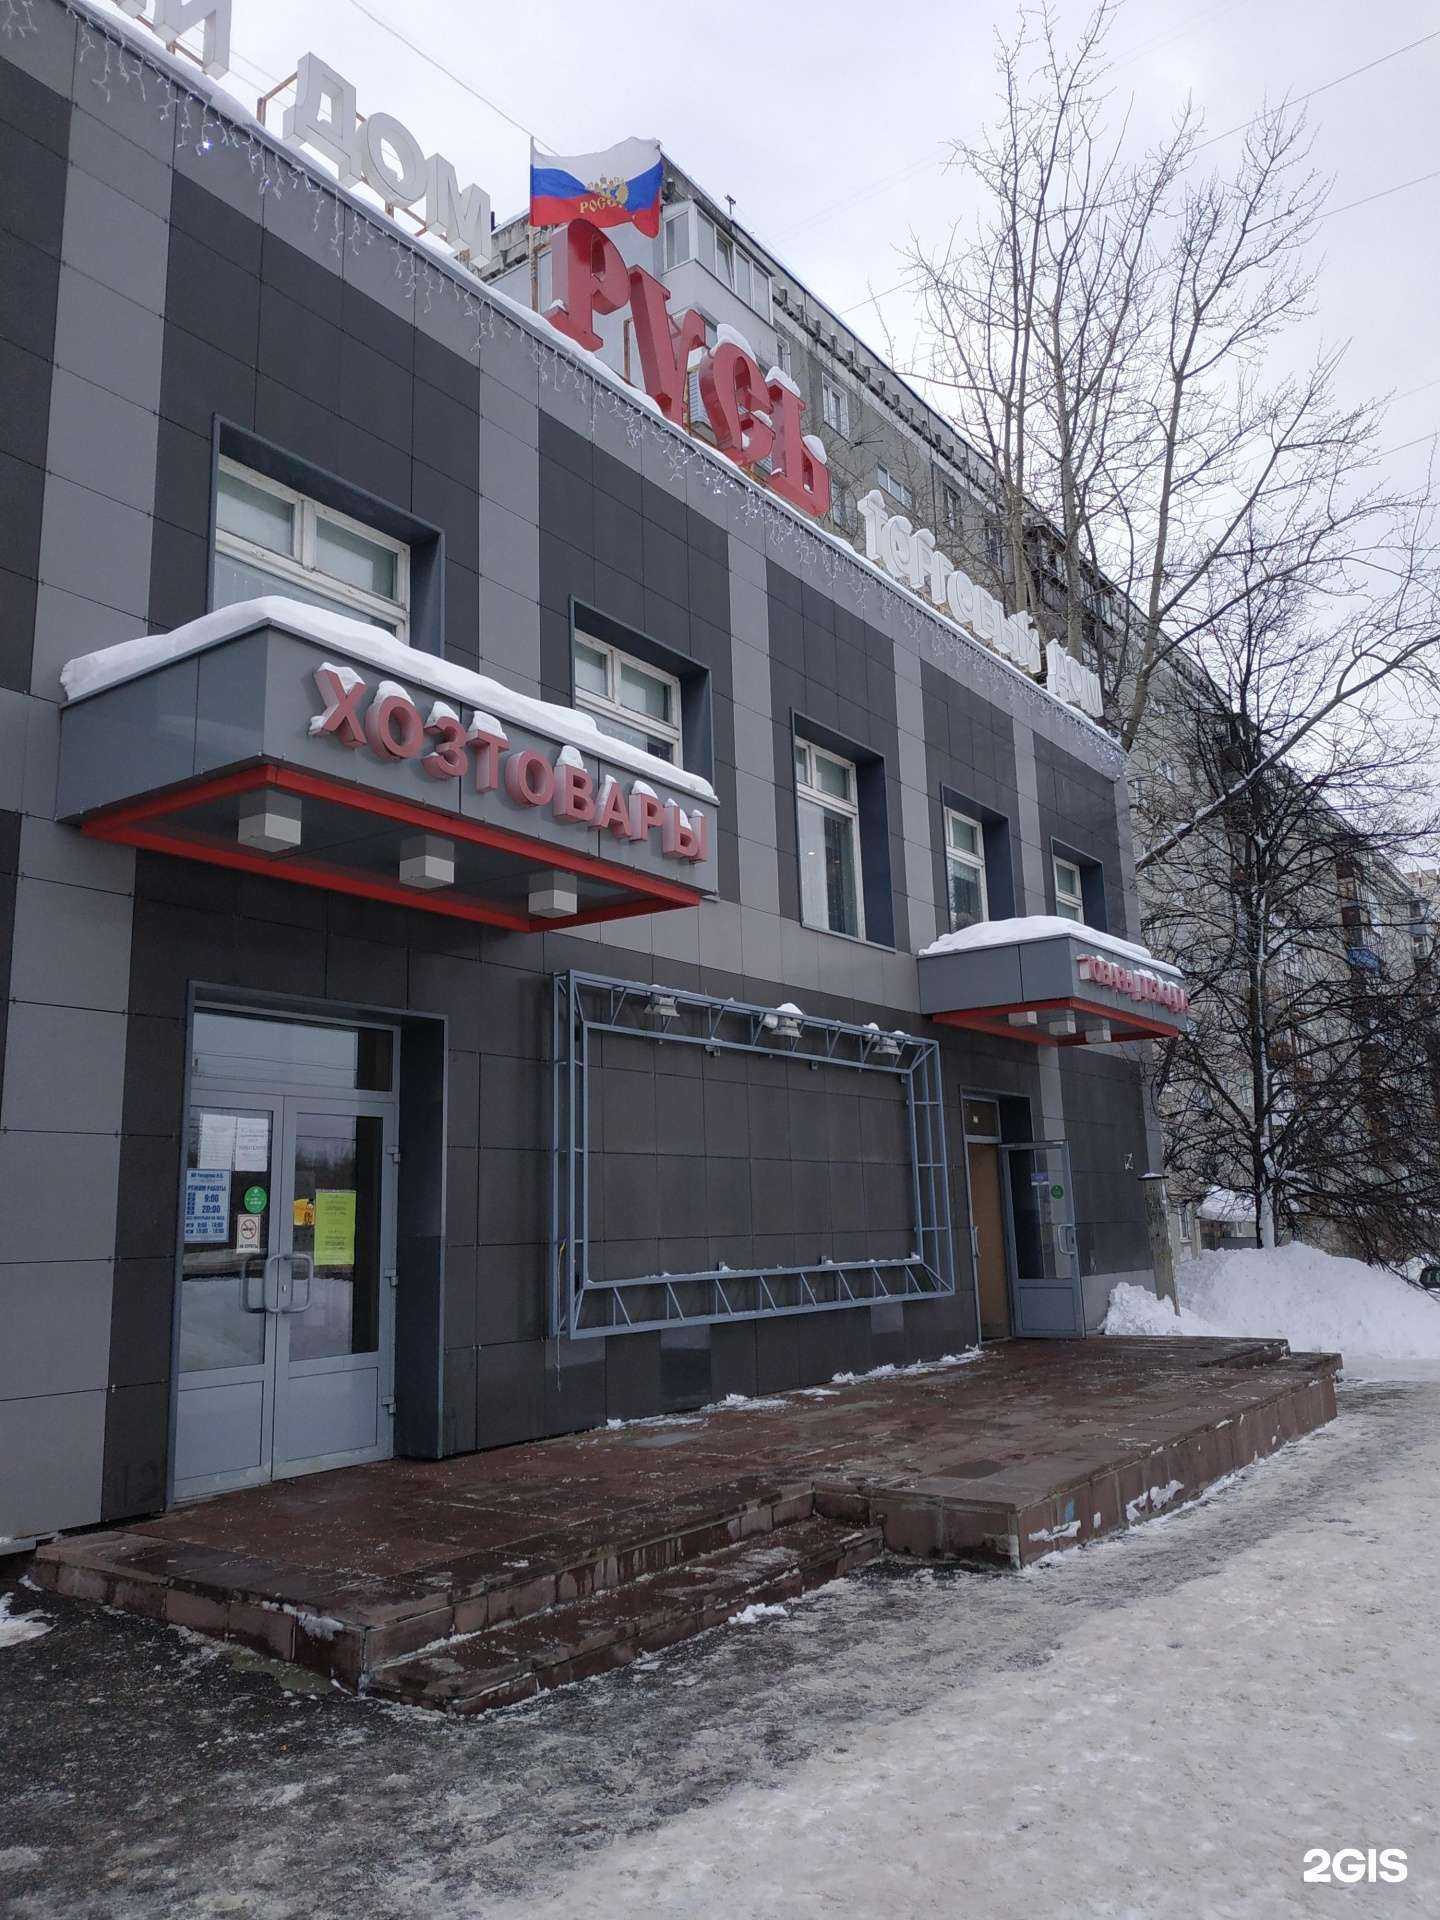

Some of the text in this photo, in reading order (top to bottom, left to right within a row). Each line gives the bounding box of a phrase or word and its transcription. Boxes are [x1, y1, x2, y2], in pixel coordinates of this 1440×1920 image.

[283, 51, 491, 270] ДОМ
[544, 217, 830, 517] РУСЬ
[309, 665, 708, 864] ХОЗТОВАРЫ
